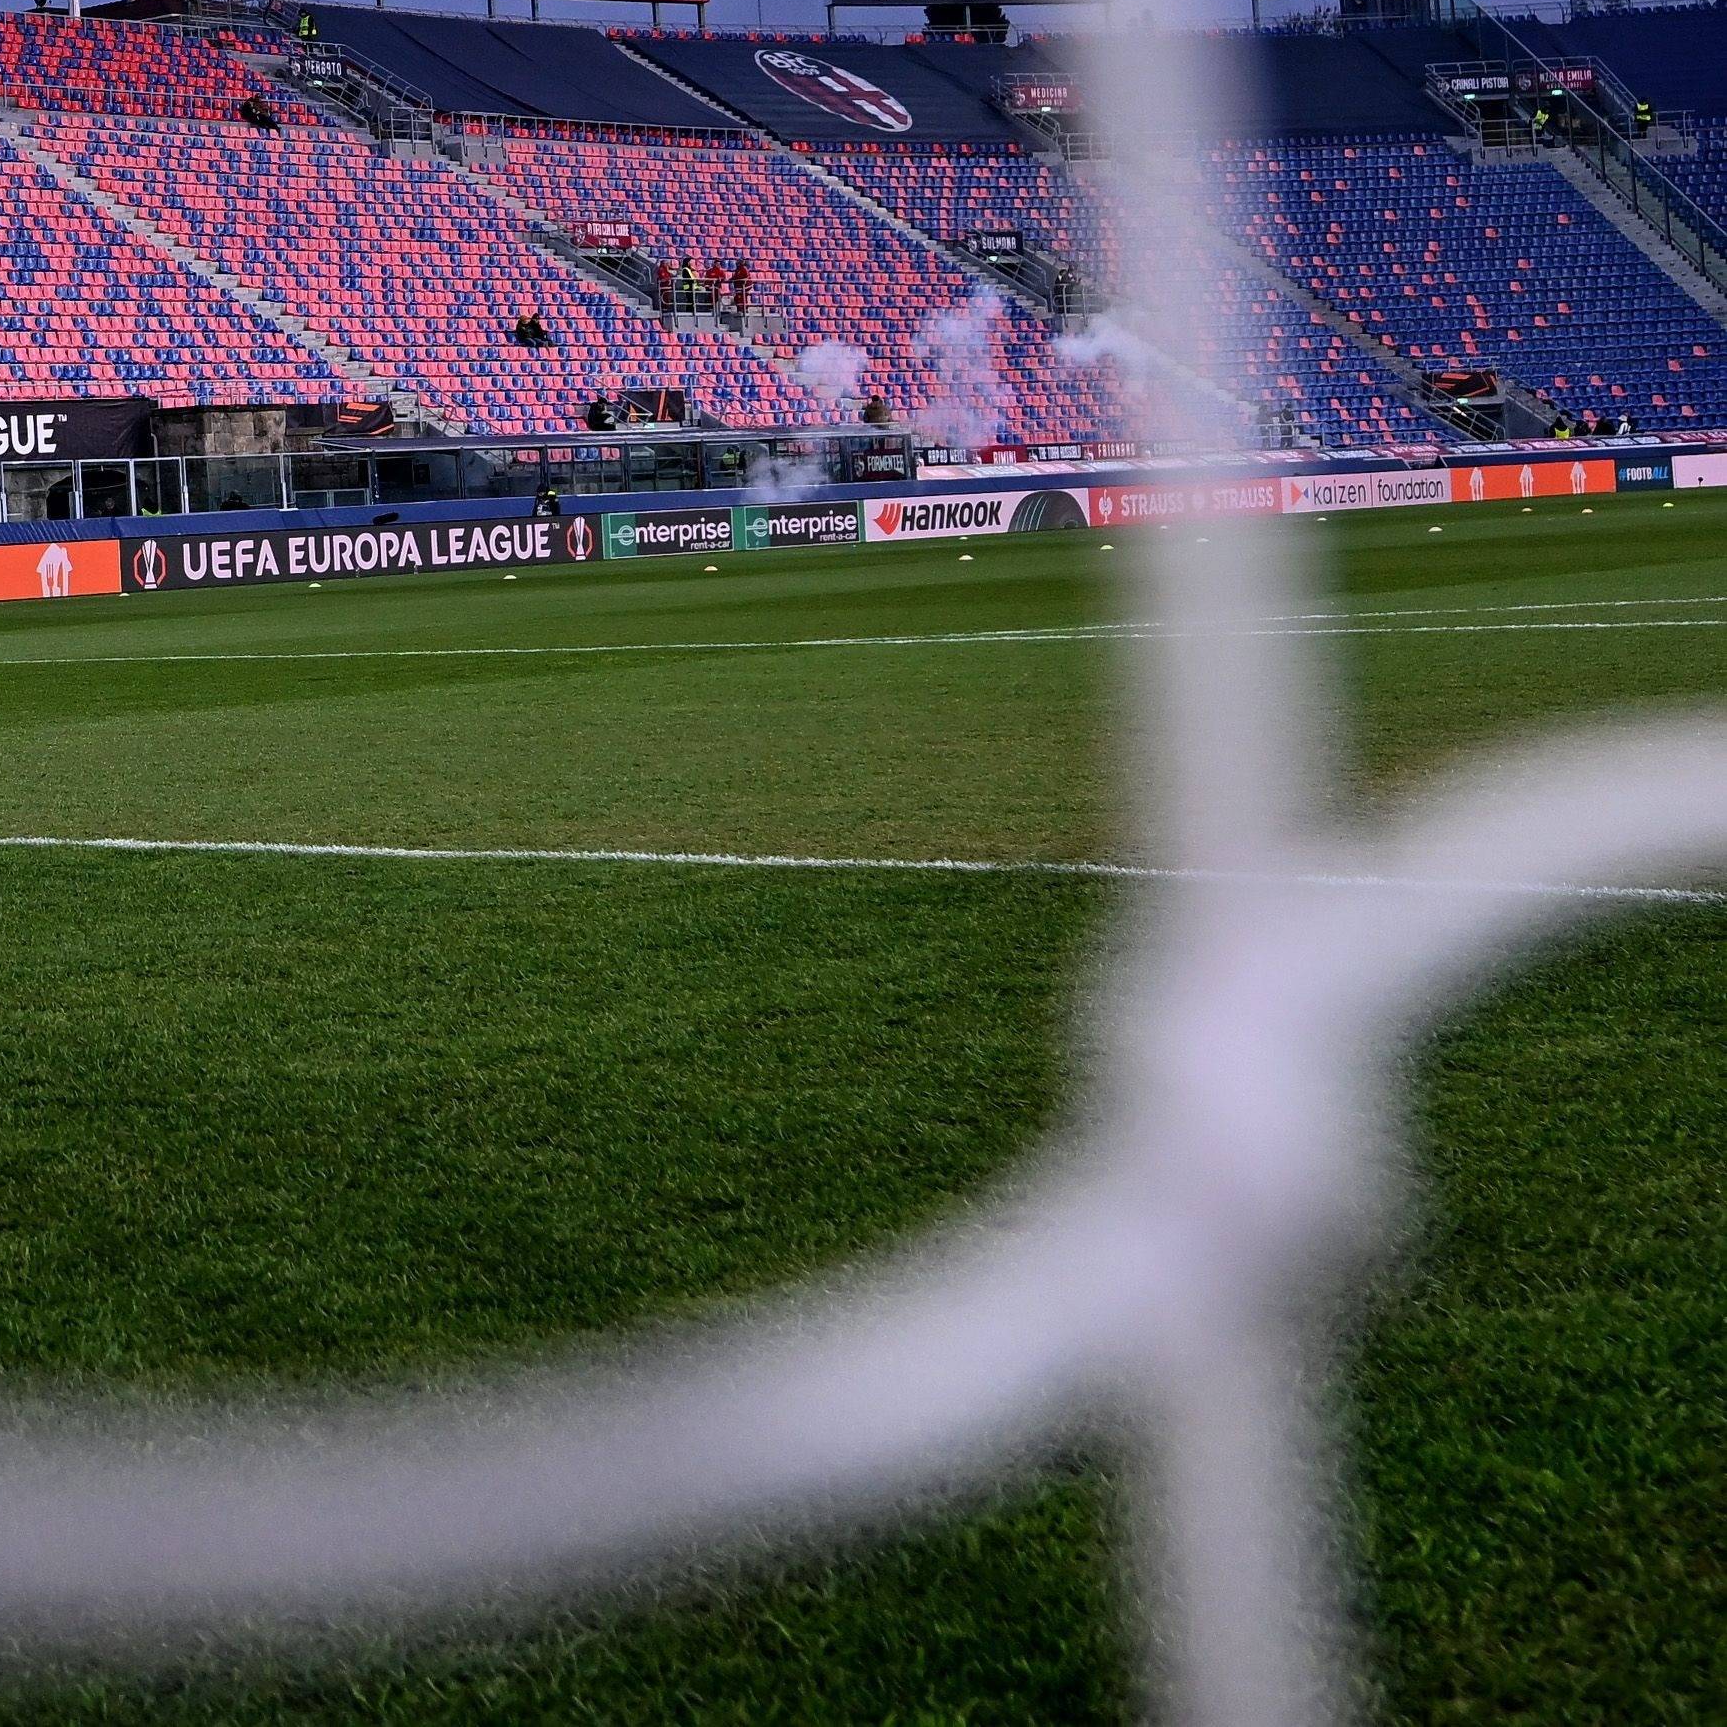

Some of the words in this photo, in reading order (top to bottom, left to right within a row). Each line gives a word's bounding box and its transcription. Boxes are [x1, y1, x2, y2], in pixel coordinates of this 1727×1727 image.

[1539, 71, 1564, 83] NZOLA
[1567, 69, 1592, 81] EMILIA
[1618, 465, 1669, 482] #FOOTBALL
[1212, 486, 1275, 511] STRAUSS
[1313, 479, 1367, 506] kaizen
[1377, 476, 1444, 503] foundation
[1120, 493, 1185, 517] STRAUSS
[618, 517, 730, 547] enterprise
[753, 510, 857, 539] enterprise
[690, 539, 731, 551] rent-a-car
[819, 531, 858, 543] rent-a-car
[182, 538, 280, 581] UEFA
[288, 532, 423, 573] EUROPA
